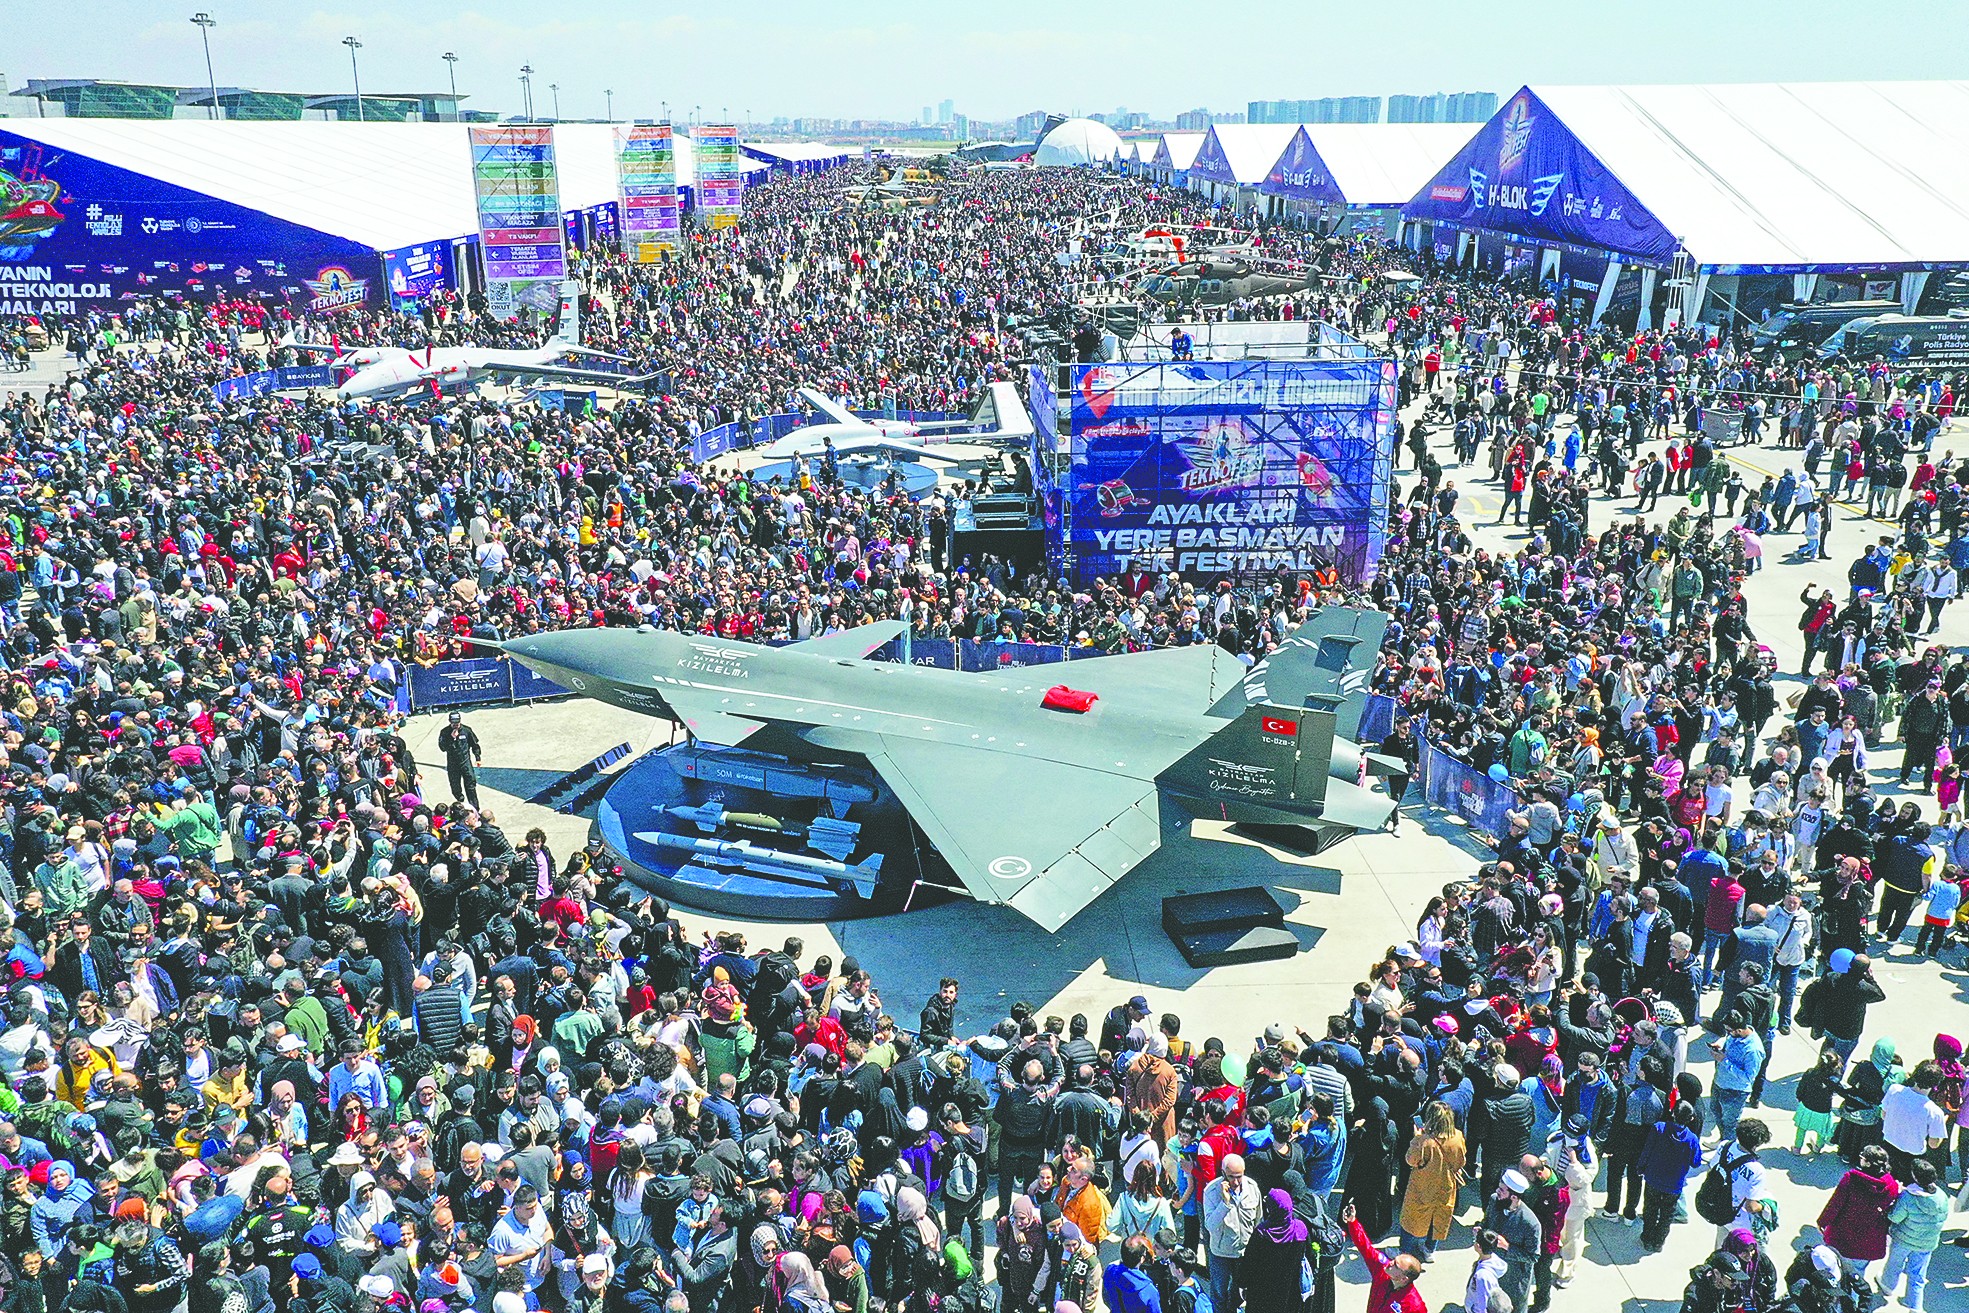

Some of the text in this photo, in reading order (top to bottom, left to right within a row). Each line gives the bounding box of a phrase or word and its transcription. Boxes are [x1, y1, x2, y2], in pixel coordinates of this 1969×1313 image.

[0, 266, 51, 280] ANIN
[311, 287, 366, 310] TEKNOFEST
[1923, 341, 1943, 349] Polis
[1147, 502, 1298, 525] AYAKLARI
[1093, 525, 1345, 551] YERE BASMAYAN
[1114, 552, 1175, 574] TEK
[677, 658, 749, 679] KIZILELMA
[693, 655, 741, 667] BAYRAKTAR
[440, 681, 500, 693] KIZILELMA
[716, 769, 733, 779] SOM
[1208, 769, 1276, 785] KIZILELMA
